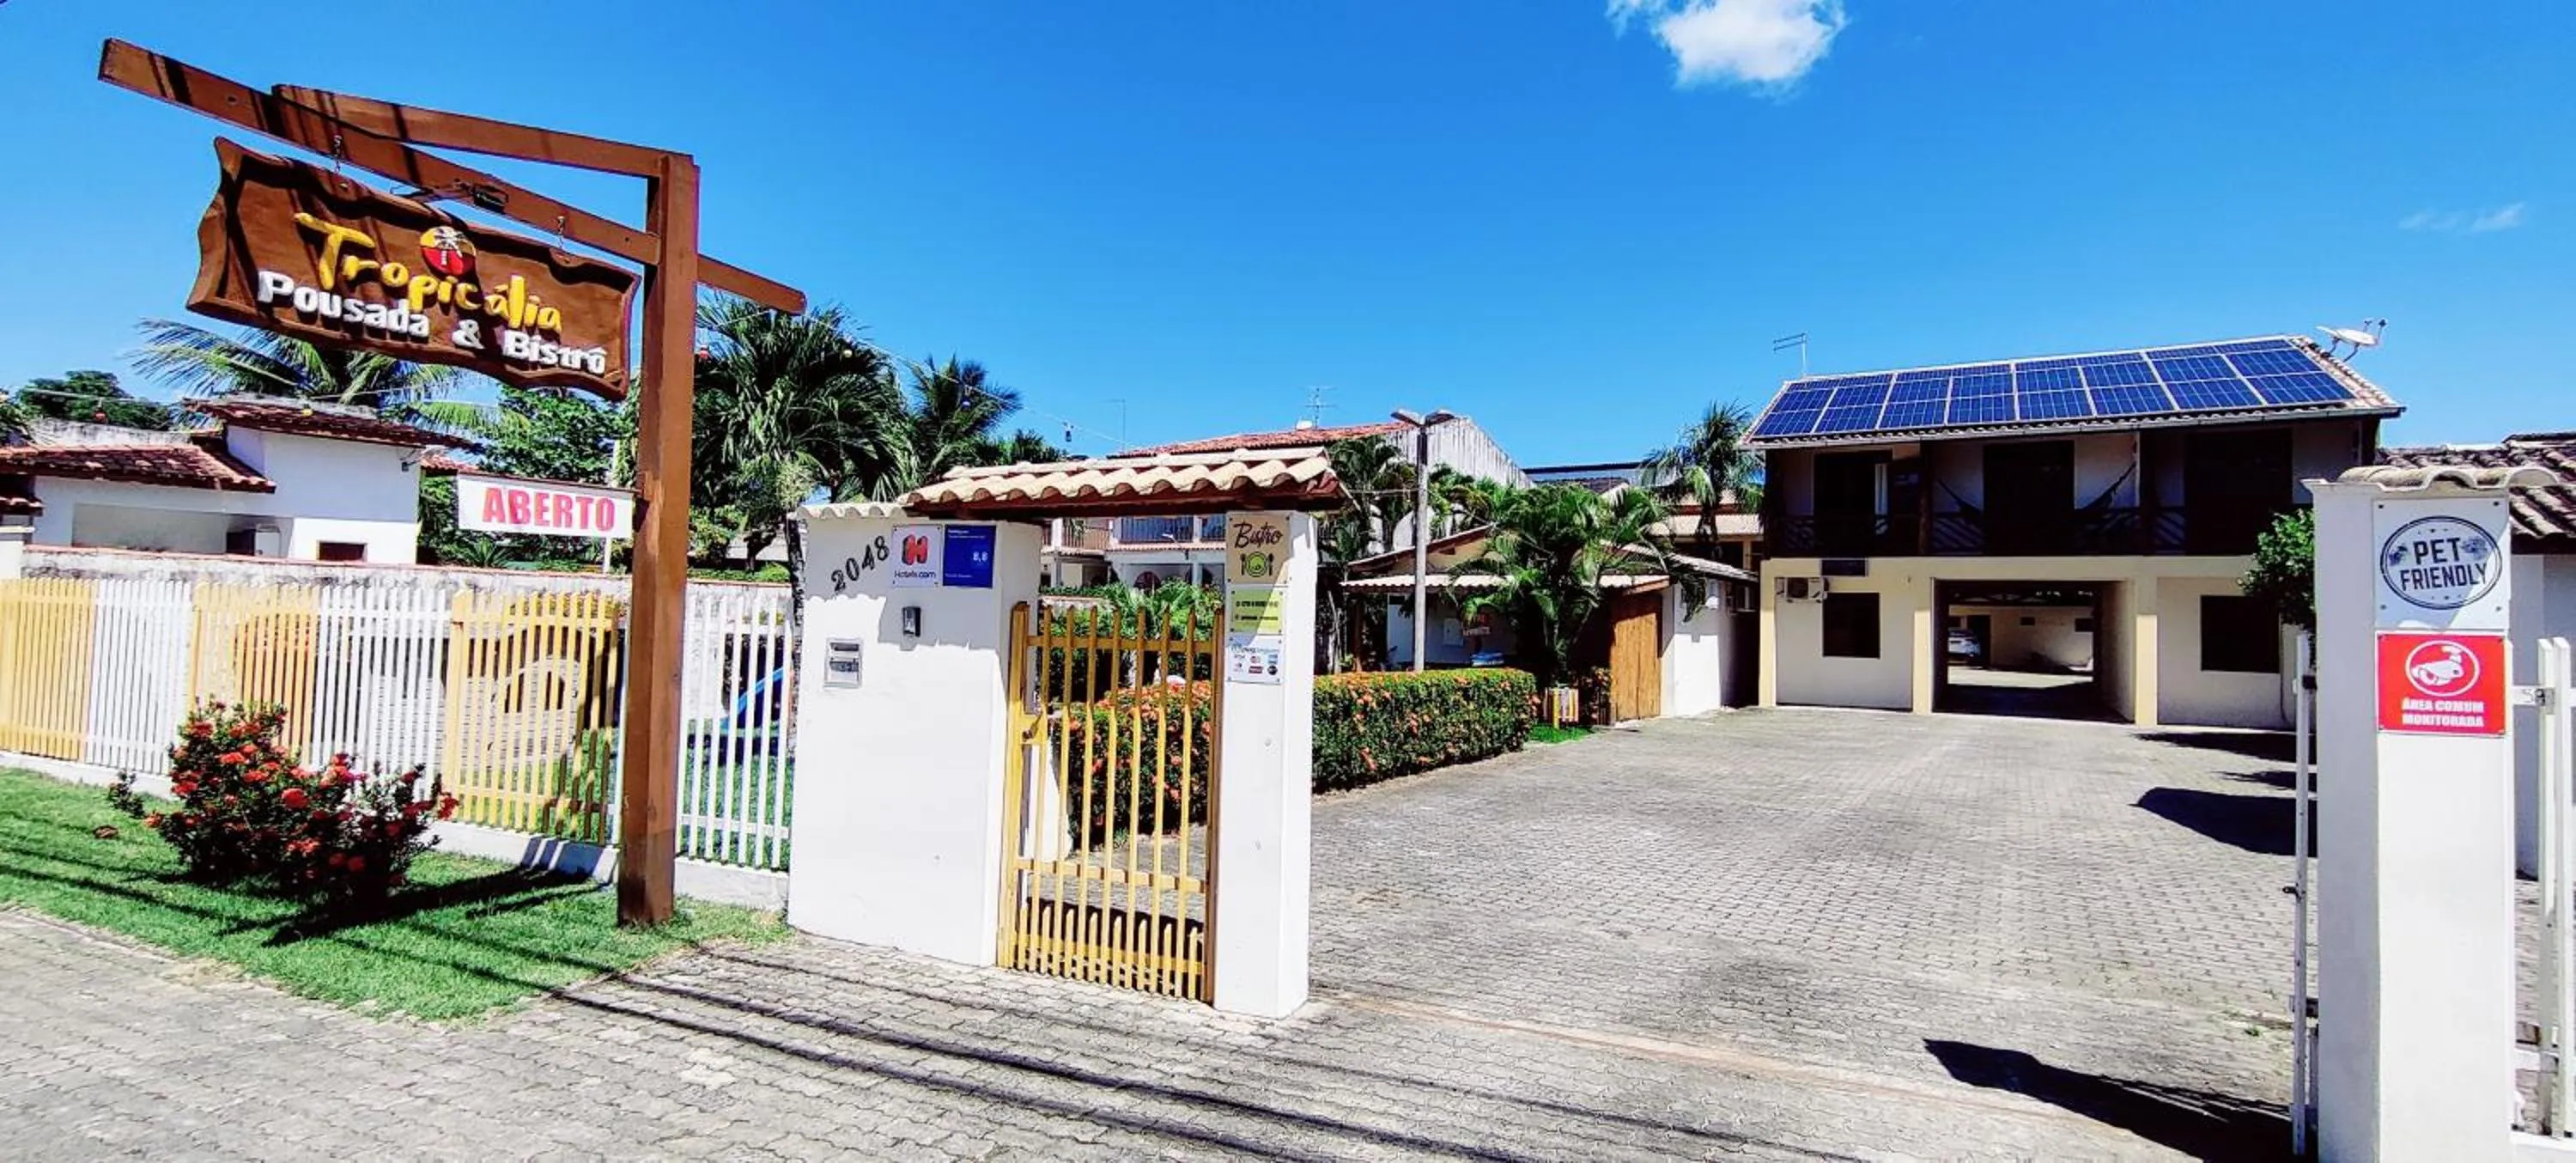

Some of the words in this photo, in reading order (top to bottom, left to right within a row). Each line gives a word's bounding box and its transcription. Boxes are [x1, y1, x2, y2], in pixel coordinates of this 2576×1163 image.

[293, 213, 562, 330] Tropicália
[258, 270, 430, 338] Pousada
[453, 319, 484, 350] &
[502, 330, 607, 374] Bistrô
[483, 487, 617, 533] ABERTO
[831, 535, 890, 593] 2048
[2414, 537, 2462, 565] PET
[894, 569, 937, 579] Hotels.com
[2401, 563, 2488, 592] FRIENDLY
[2402, 714, 2484, 728] MONITORADA
[2434, 700, 2484, 713] COMUM
